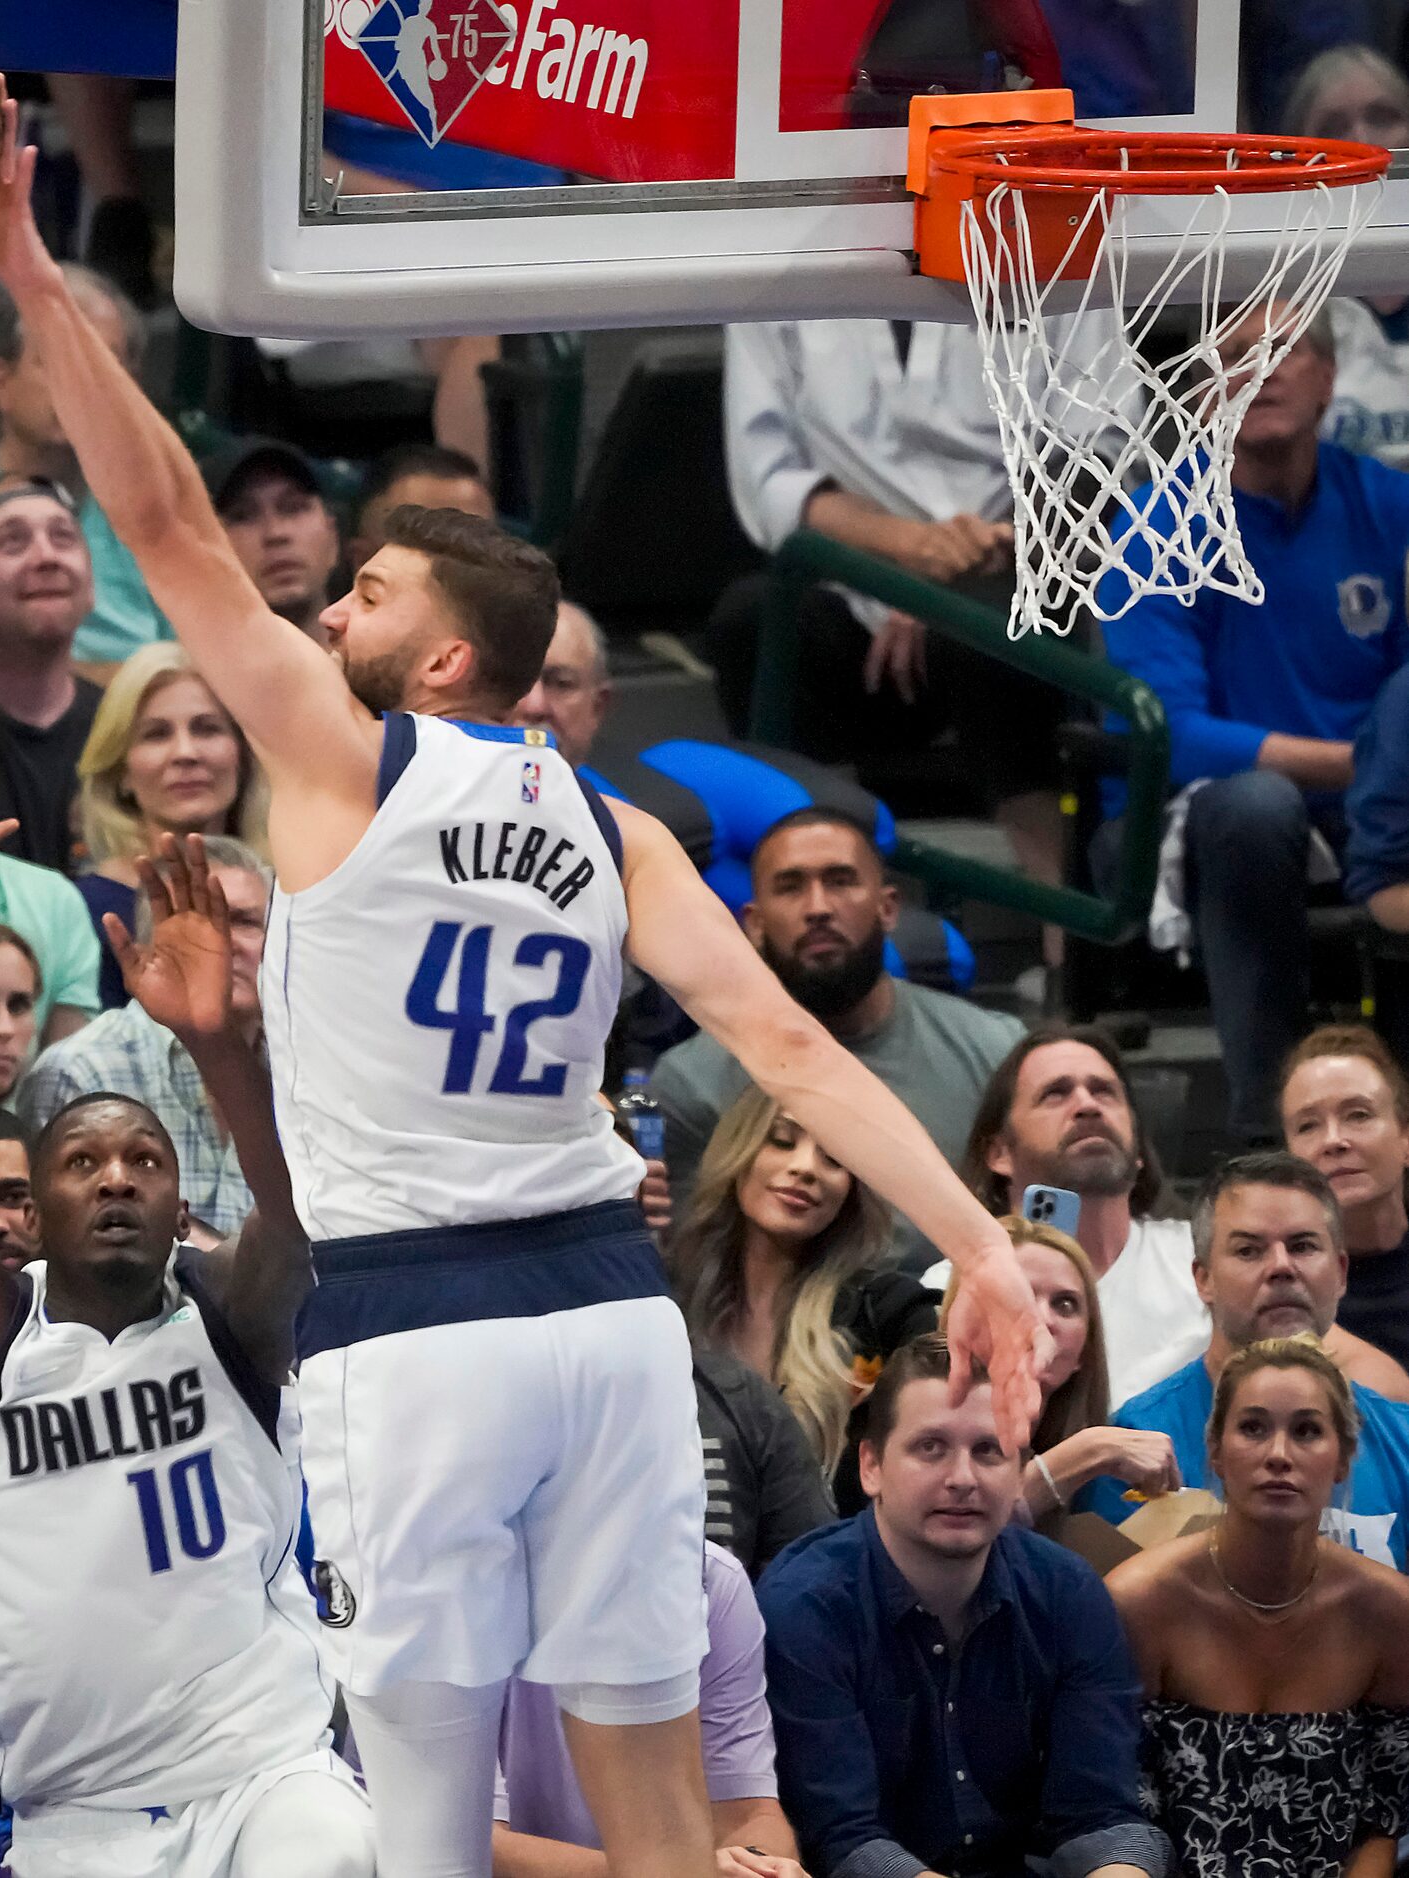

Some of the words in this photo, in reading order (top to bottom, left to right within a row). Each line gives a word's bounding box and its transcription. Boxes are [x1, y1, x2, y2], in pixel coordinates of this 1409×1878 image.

[449, 14, 479, 59] 75
[439, 822, 595, 911] KLEBER
[404, 920, 592, 1097] 42
[125, 1447, 227, 1576] 10
